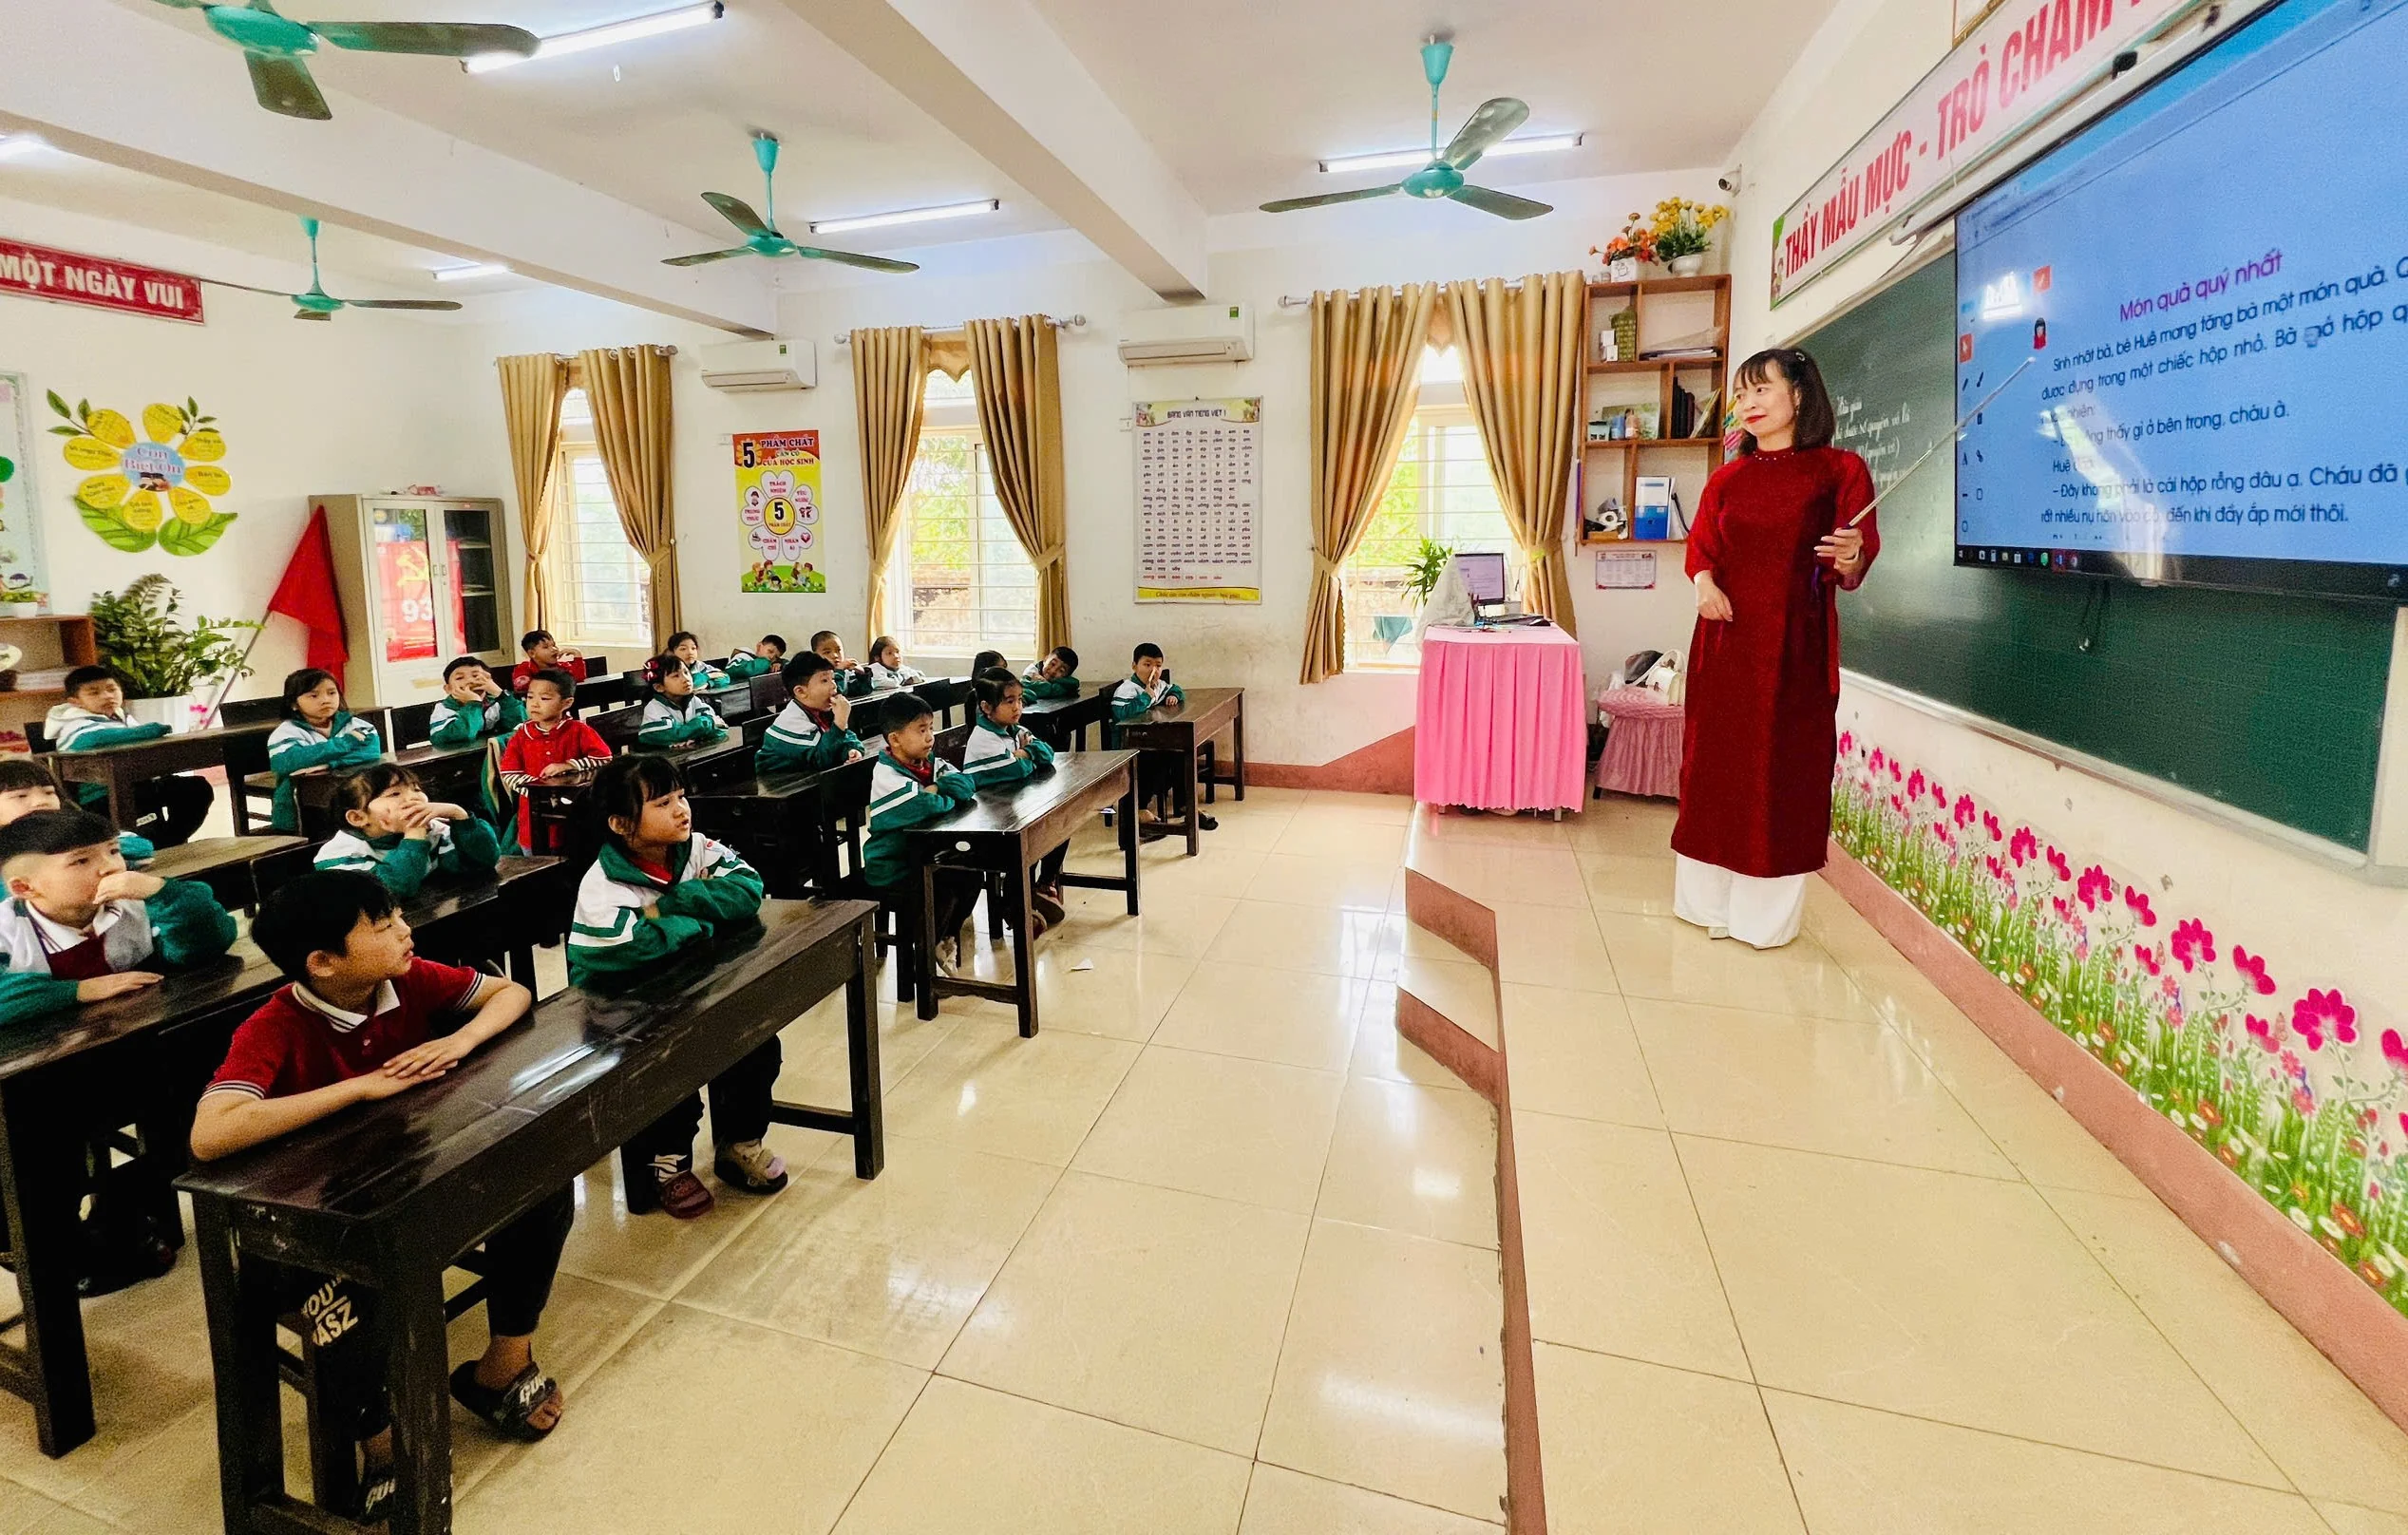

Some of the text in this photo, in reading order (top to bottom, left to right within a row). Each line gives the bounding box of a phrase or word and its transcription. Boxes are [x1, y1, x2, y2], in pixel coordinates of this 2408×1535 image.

[1821, 167, 1860, 251] MẪU
[1937, 41, 1990, 161] TRÒ
[0, 252, 184, 310] MỘT NGÀY VUI
[2120, 248, 2283, 322] Món quà quý nhất
[2053, 356, 2071, 372] Sinh
[2160, 322, 2196, 343] mang
[2237, 302, 2258, 323] bà
[2263, 292, 2294, 316] một
[2299, 281, 2341, 306] món
[2098, 371, 2126, 387] trong
[2130, 364, 2152, 381] một
[2157, 350, 2194, 374] chiếc
[2199, 347, 2228, 366] hộp
[2275, 327, 2297, 348] Bà
[2156, 418, 2182, 434] bên
[2229, 404, 2269, 425] cháu
[743, 443, 755, 468] 5
[2180, 476, 2207, 495] hộp
[2249, 470, 2282, 488] đâu
[2309, 465, 2362, 486] Cháu
[2368, 464, 2399, 483] đã
[774, 502, 785, 520] 5
[2194, 506, 2211, 522] khi
[2274, 504, 2305, 521] mới
[2309, 503, 2349, 521] thôi.
